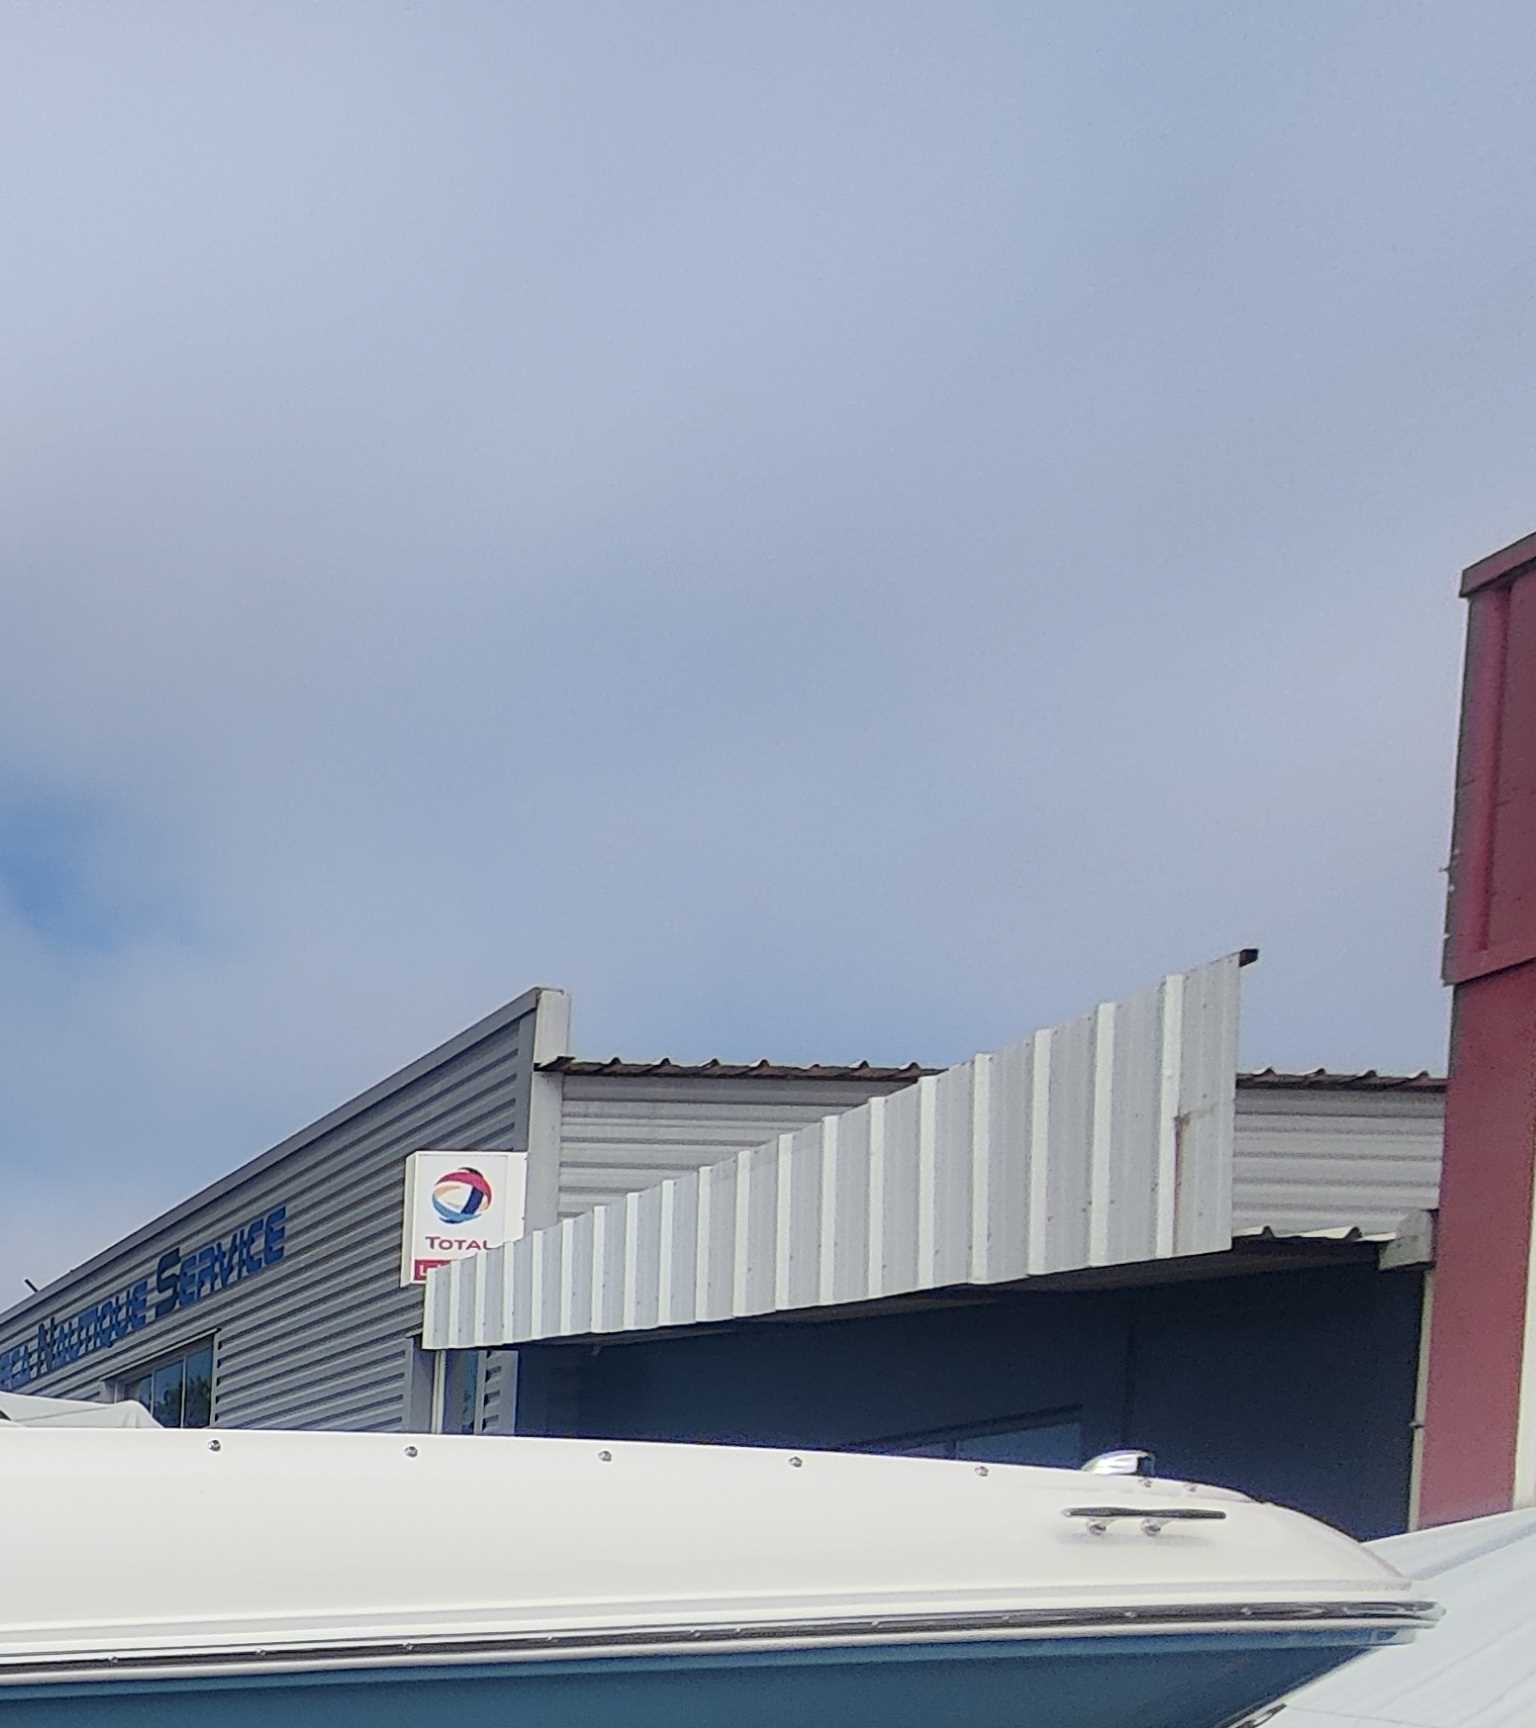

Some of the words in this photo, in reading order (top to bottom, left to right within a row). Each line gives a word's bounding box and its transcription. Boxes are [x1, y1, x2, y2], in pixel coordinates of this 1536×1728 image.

[425, 1235, 497, 1251] TOTAL
[38, 1280, 148, 1371] NAUTIQUE
[155, 1206, 287, 1319] SERVICE
